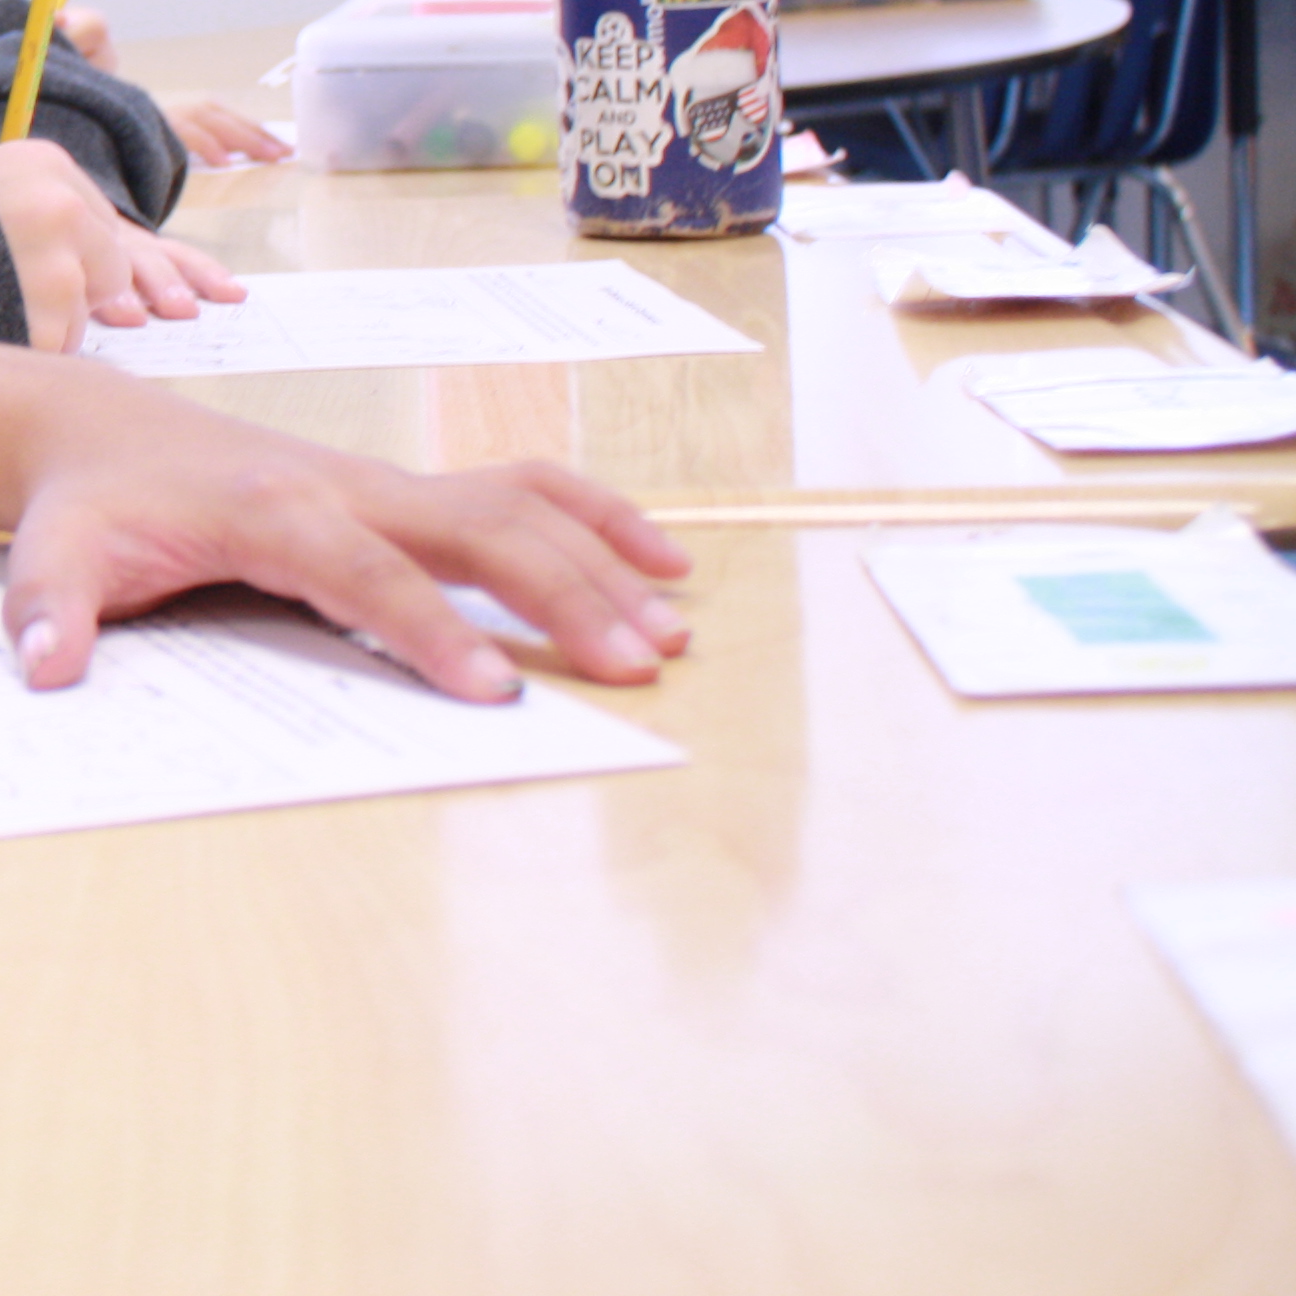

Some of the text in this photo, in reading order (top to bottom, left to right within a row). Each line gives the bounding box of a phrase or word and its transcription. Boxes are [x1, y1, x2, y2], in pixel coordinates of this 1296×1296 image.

[577, 41, 654, 71] KEEP
[576, 76, 663, 103] CALM
[597, 109, 637, 126] AND
[580, 128, 663, 156] PLAY
[593, 161, 641, 189] ON
